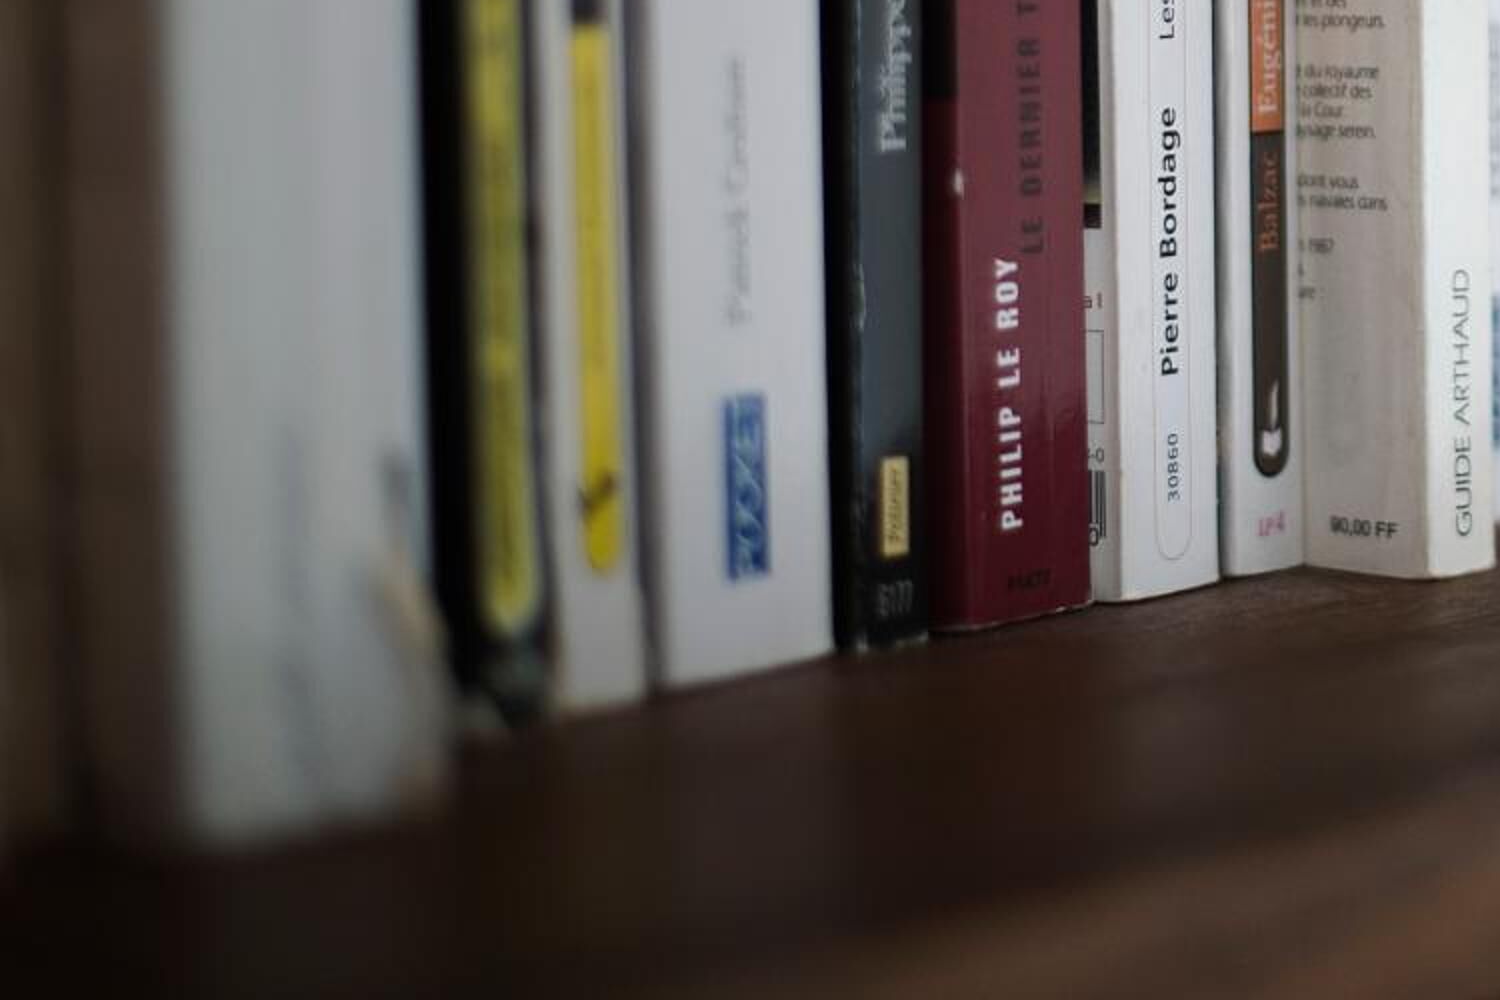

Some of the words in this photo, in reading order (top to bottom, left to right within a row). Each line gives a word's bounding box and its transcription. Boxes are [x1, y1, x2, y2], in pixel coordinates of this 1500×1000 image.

[1015, 37, 1043, 197] DERNIER
[1155, 108, 1182, 262] Bordage
[1256, 151, 1280, 253] Balzac
[1018, 220, 1045, 258] LE
[992, 258, 1021, 331] ROY
[1157, 273, 1180, 379] Pierre
[995, 349, 1022, 390] LE
[1451, 270, 1471, 426] ARTHAUD
[997, 407, 1025, 532] PHILIP
[1165, 434, 1180, 504] 30860
[1454, 437, 1473, 538] GUIDE
[1374, 518, 1400, 539] FF
